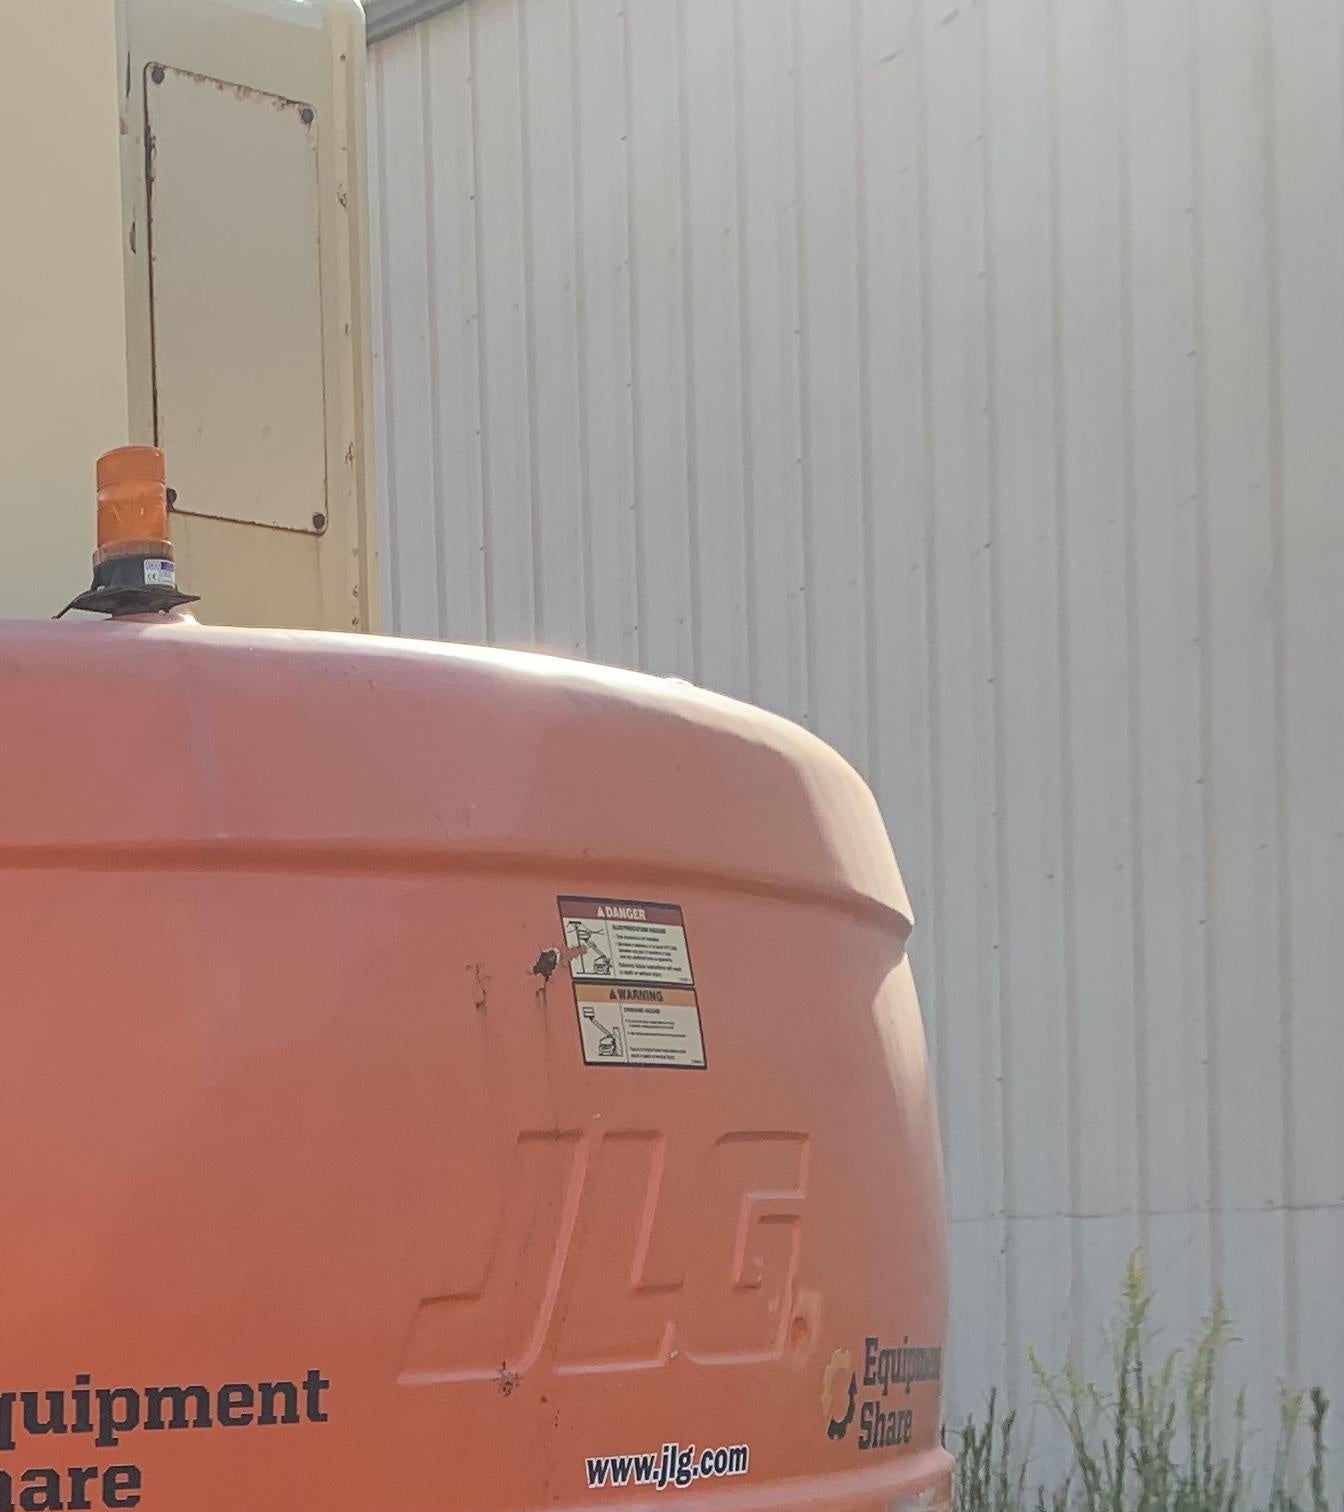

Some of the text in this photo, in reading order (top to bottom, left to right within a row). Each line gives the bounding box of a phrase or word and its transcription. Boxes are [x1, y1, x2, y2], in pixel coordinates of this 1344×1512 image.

[605, 906, 646, 920] DANGER
[617, 988, 664, 1002] WARNING
[397, 1130, 809, 1384] JLG
[858, 1401, 913, 1450] Share
[586, 1443, 749, 1489] www.jlg.com
